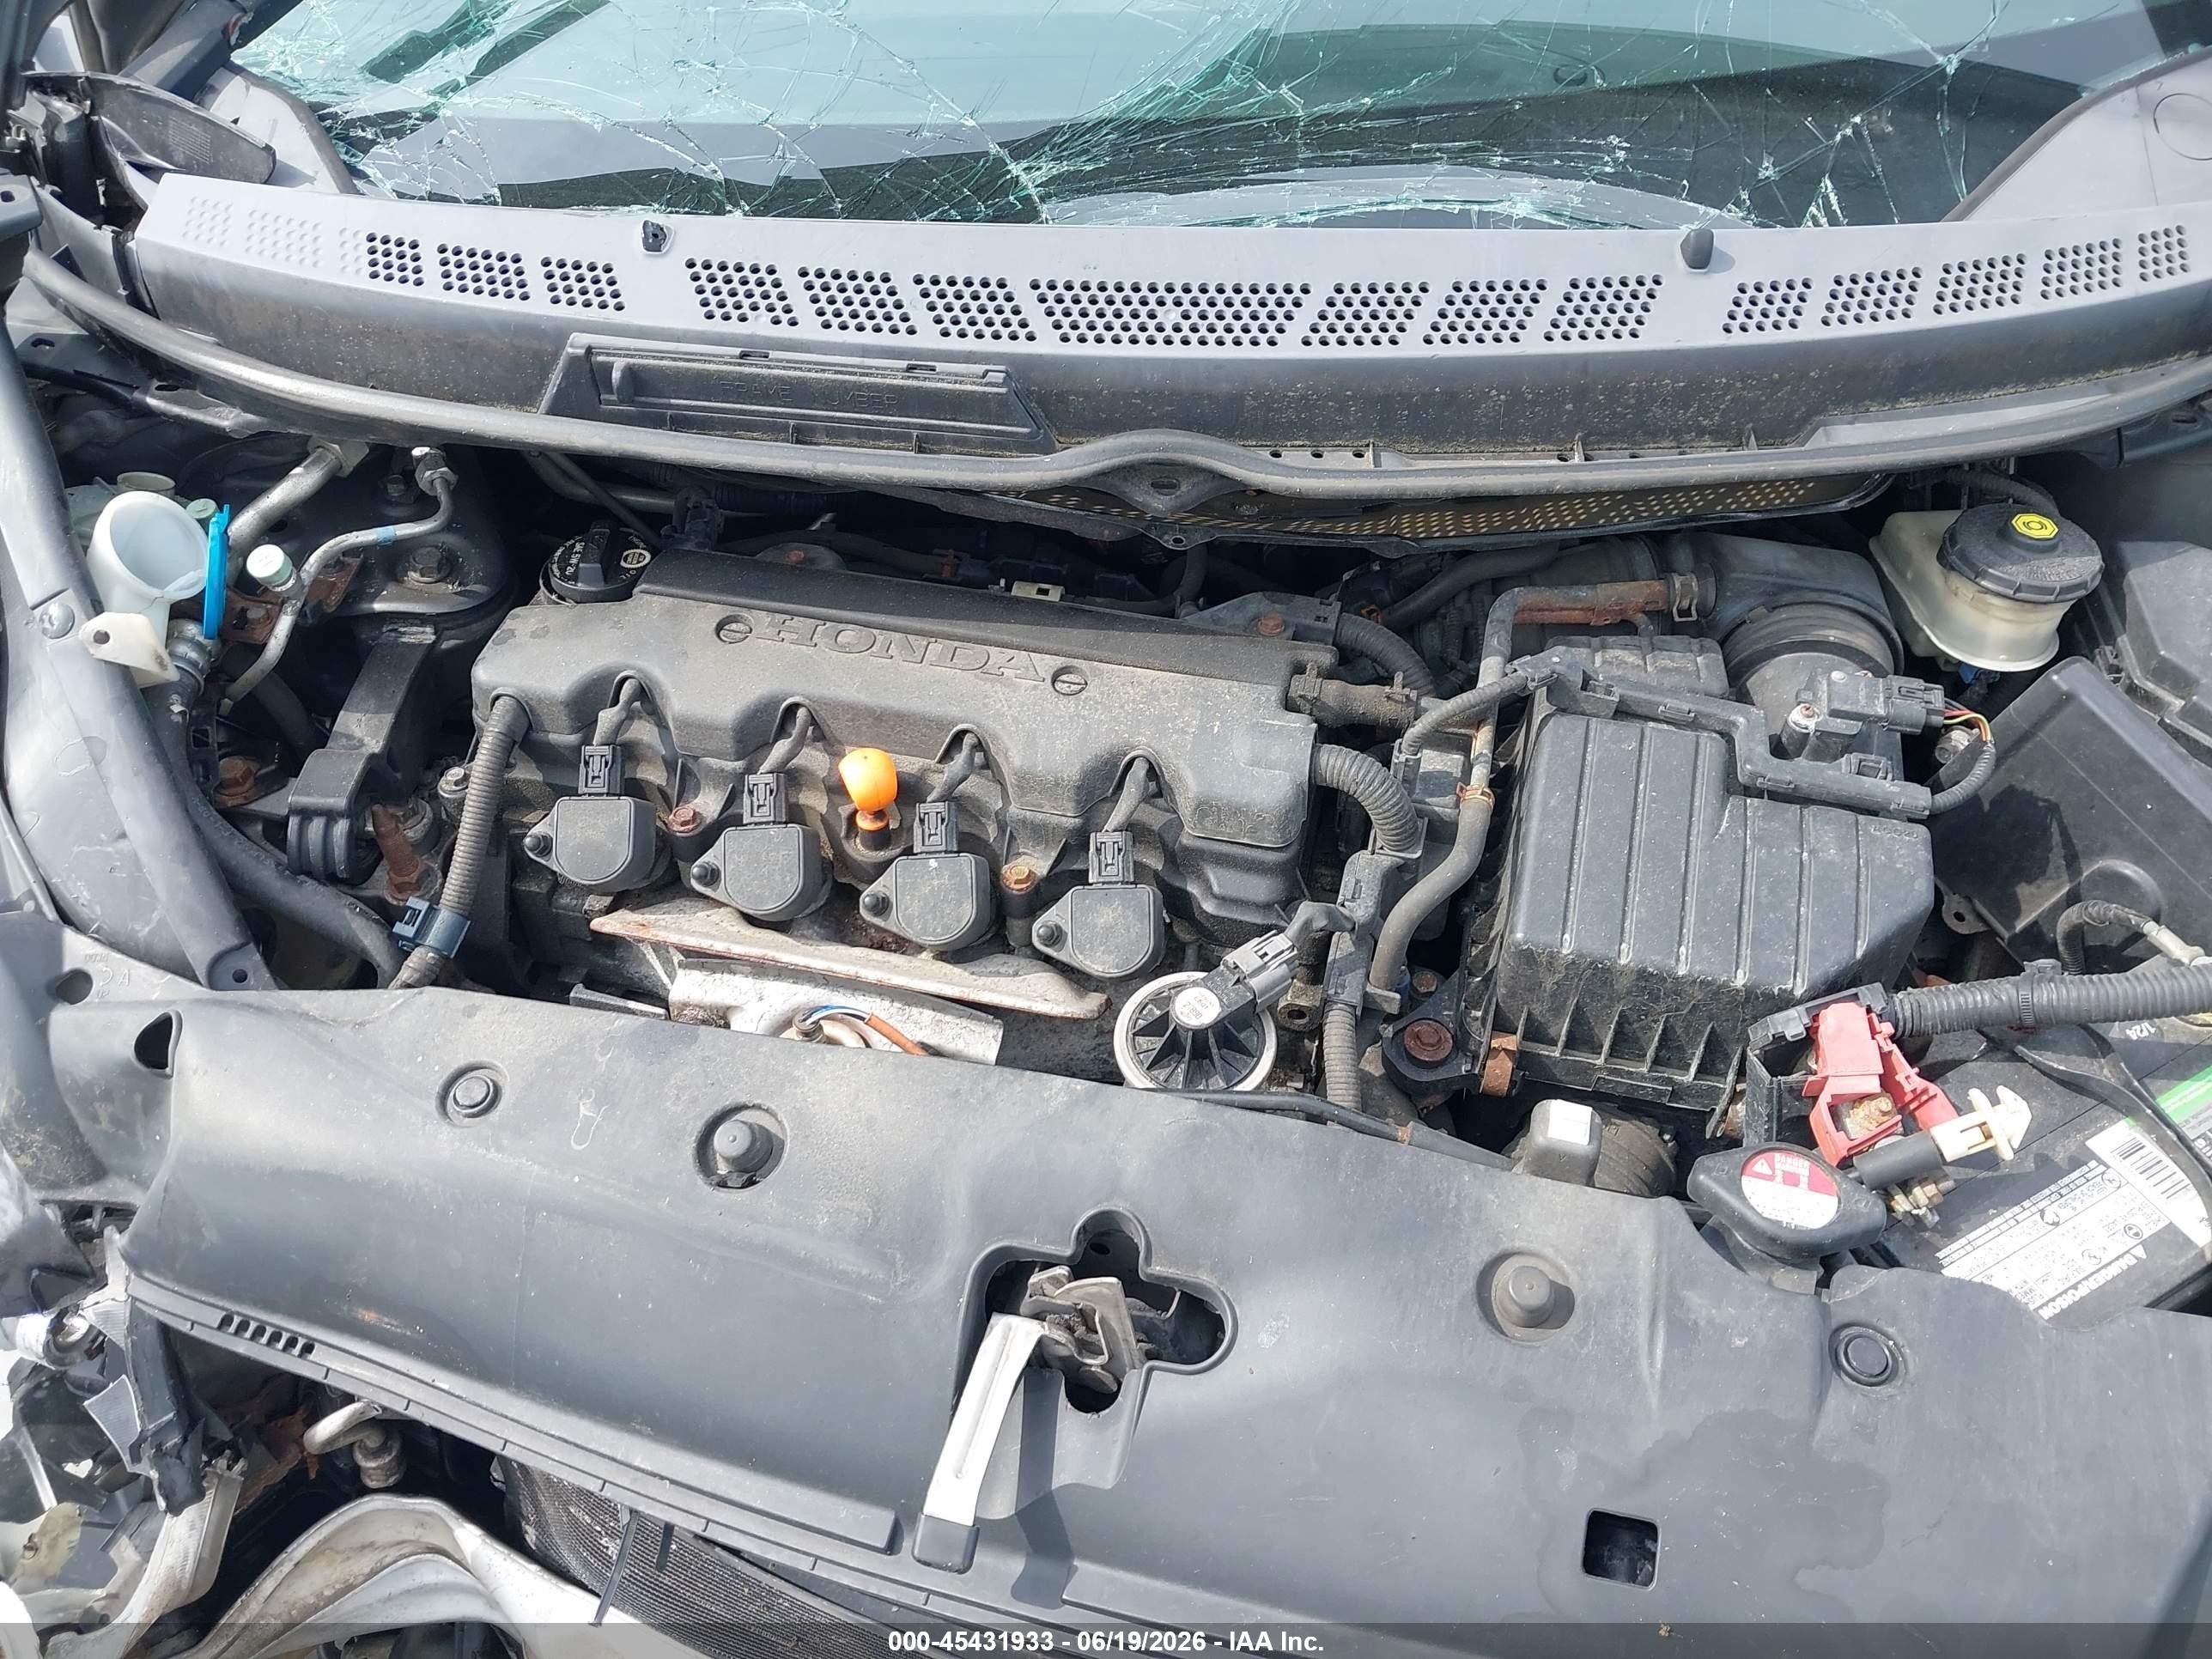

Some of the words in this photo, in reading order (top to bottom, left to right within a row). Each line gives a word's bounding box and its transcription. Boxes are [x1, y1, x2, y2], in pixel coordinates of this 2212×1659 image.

[754, 613, 1047, 684] HONDA
[2126, 1022, 2156, 1041] 1/24
[2037, 1252, 2137, 1320] DANGER/POISON
